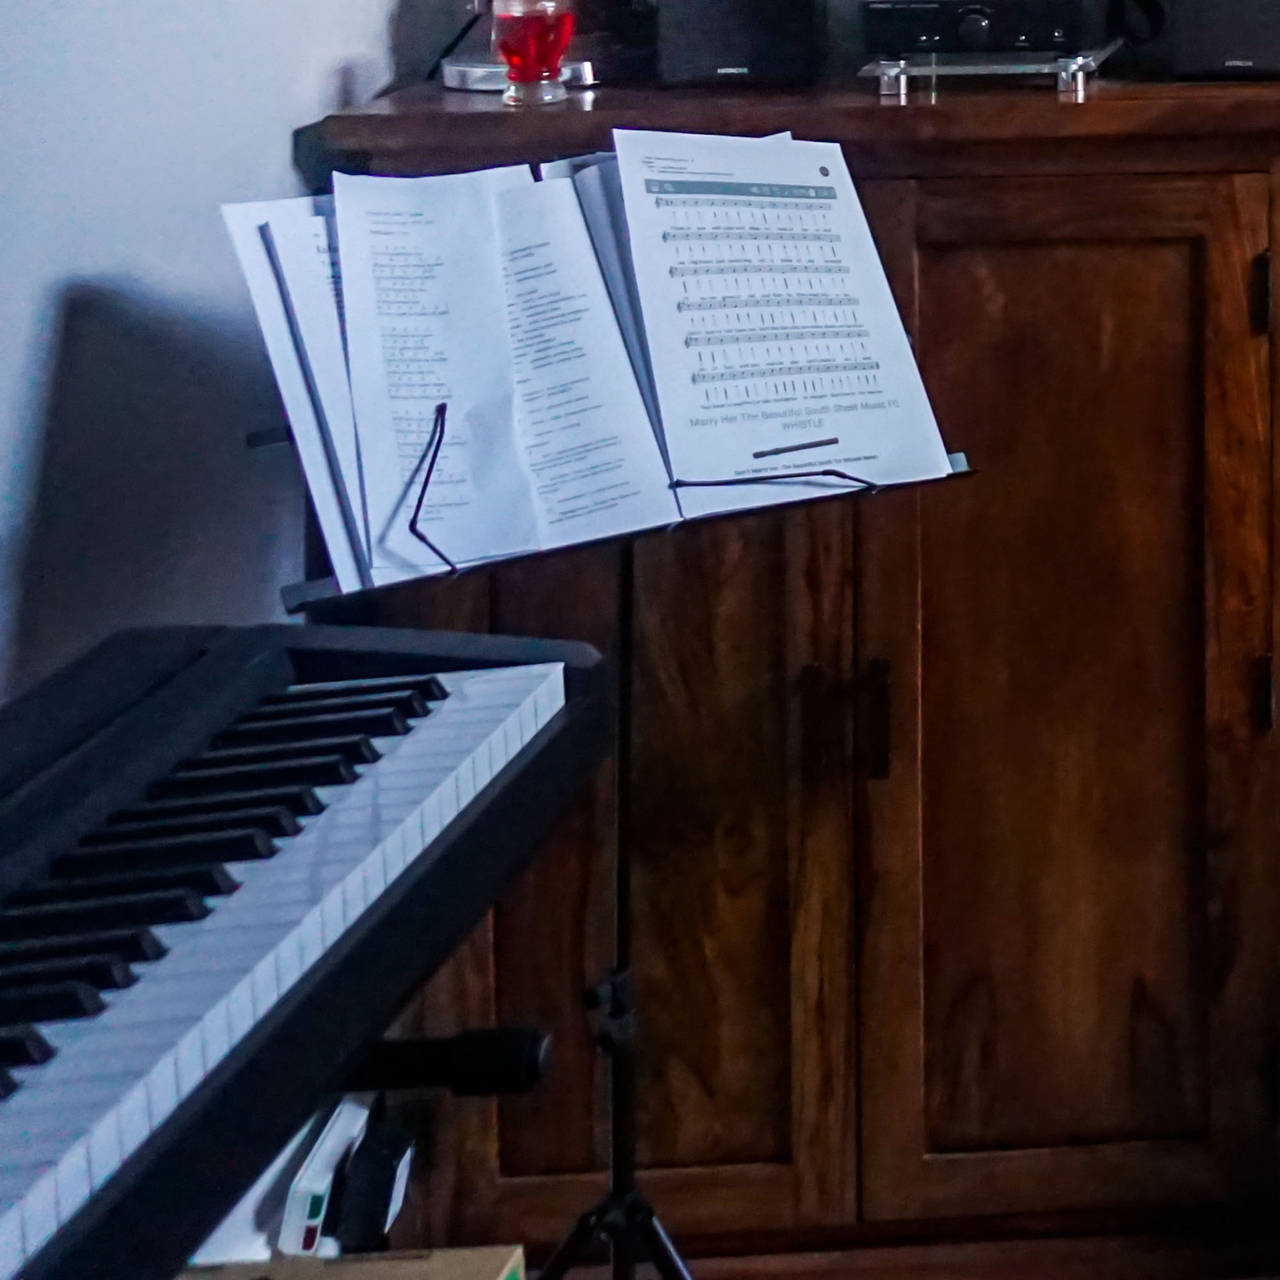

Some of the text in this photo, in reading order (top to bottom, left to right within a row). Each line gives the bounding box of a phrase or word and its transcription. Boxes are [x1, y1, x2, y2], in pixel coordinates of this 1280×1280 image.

[689, 417, 718, 429] Marry
[721, 415, 738, 425] Her
[740, 413, 759, 423] The
[761, 408, 803, 421] Beautiful
[804, 405, 832, 416] South
[833, 403, 859, 414] Sheet
[860, 401, 887, 411] Music
[781, 419, 825, 431] WHISTLE
